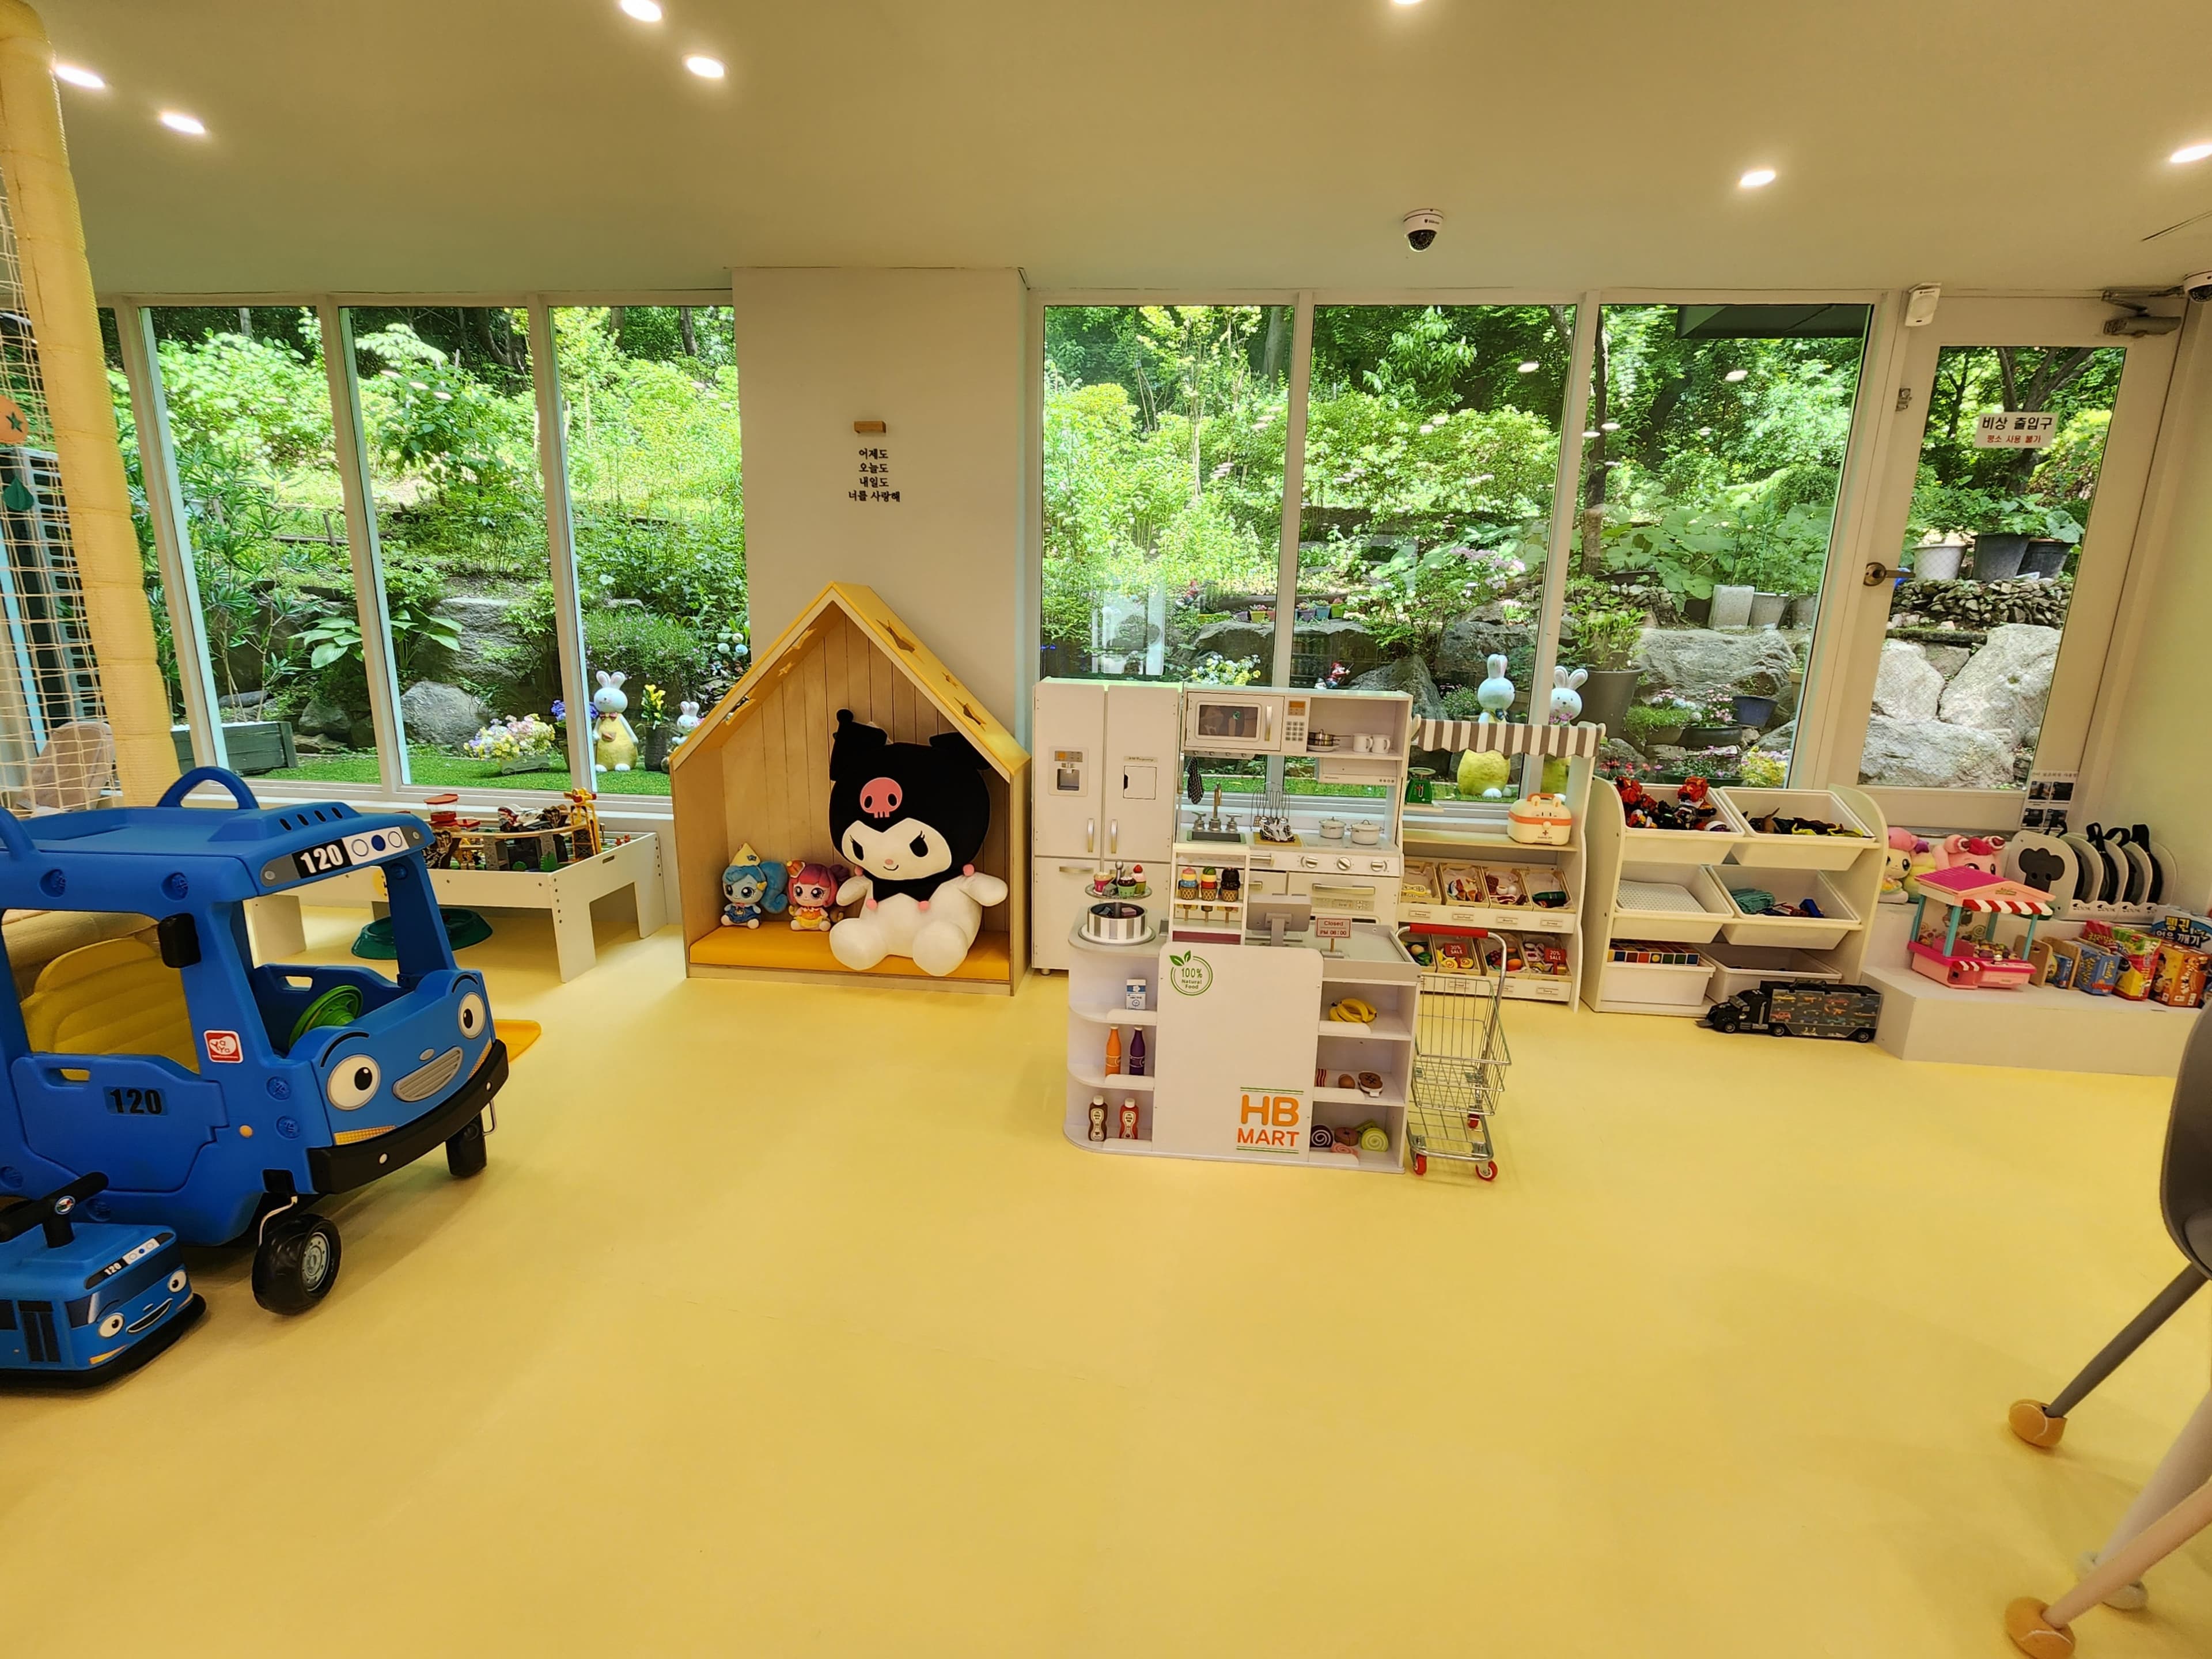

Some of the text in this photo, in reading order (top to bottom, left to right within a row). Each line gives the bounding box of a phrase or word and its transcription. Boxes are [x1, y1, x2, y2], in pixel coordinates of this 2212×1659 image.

[1982, 417, 2052, 430] 비상 출입구
[1987, 435, 2041, 443] 평소 사용 불가
[859, 448, 888, 460] 어제도
[859, 463, 889, 474] 오늘도
[859, 476, 889, 488] 내일도
[849, 490, 900, 502] 너를 사랑해
[300, 844, 344, 874] 120
[2165, 916, 2191, 933] 펭귄
[2177, 933, 2200, 946] 깨기
[1181, 968, 1203, 978] 100%
[109, 1088, 162, 1115] 120
[1241, 1094, 1299, 1127] HB
[1237, 1127, 1300, 1147] MART
[104, 1262, 122, 1275] 120
